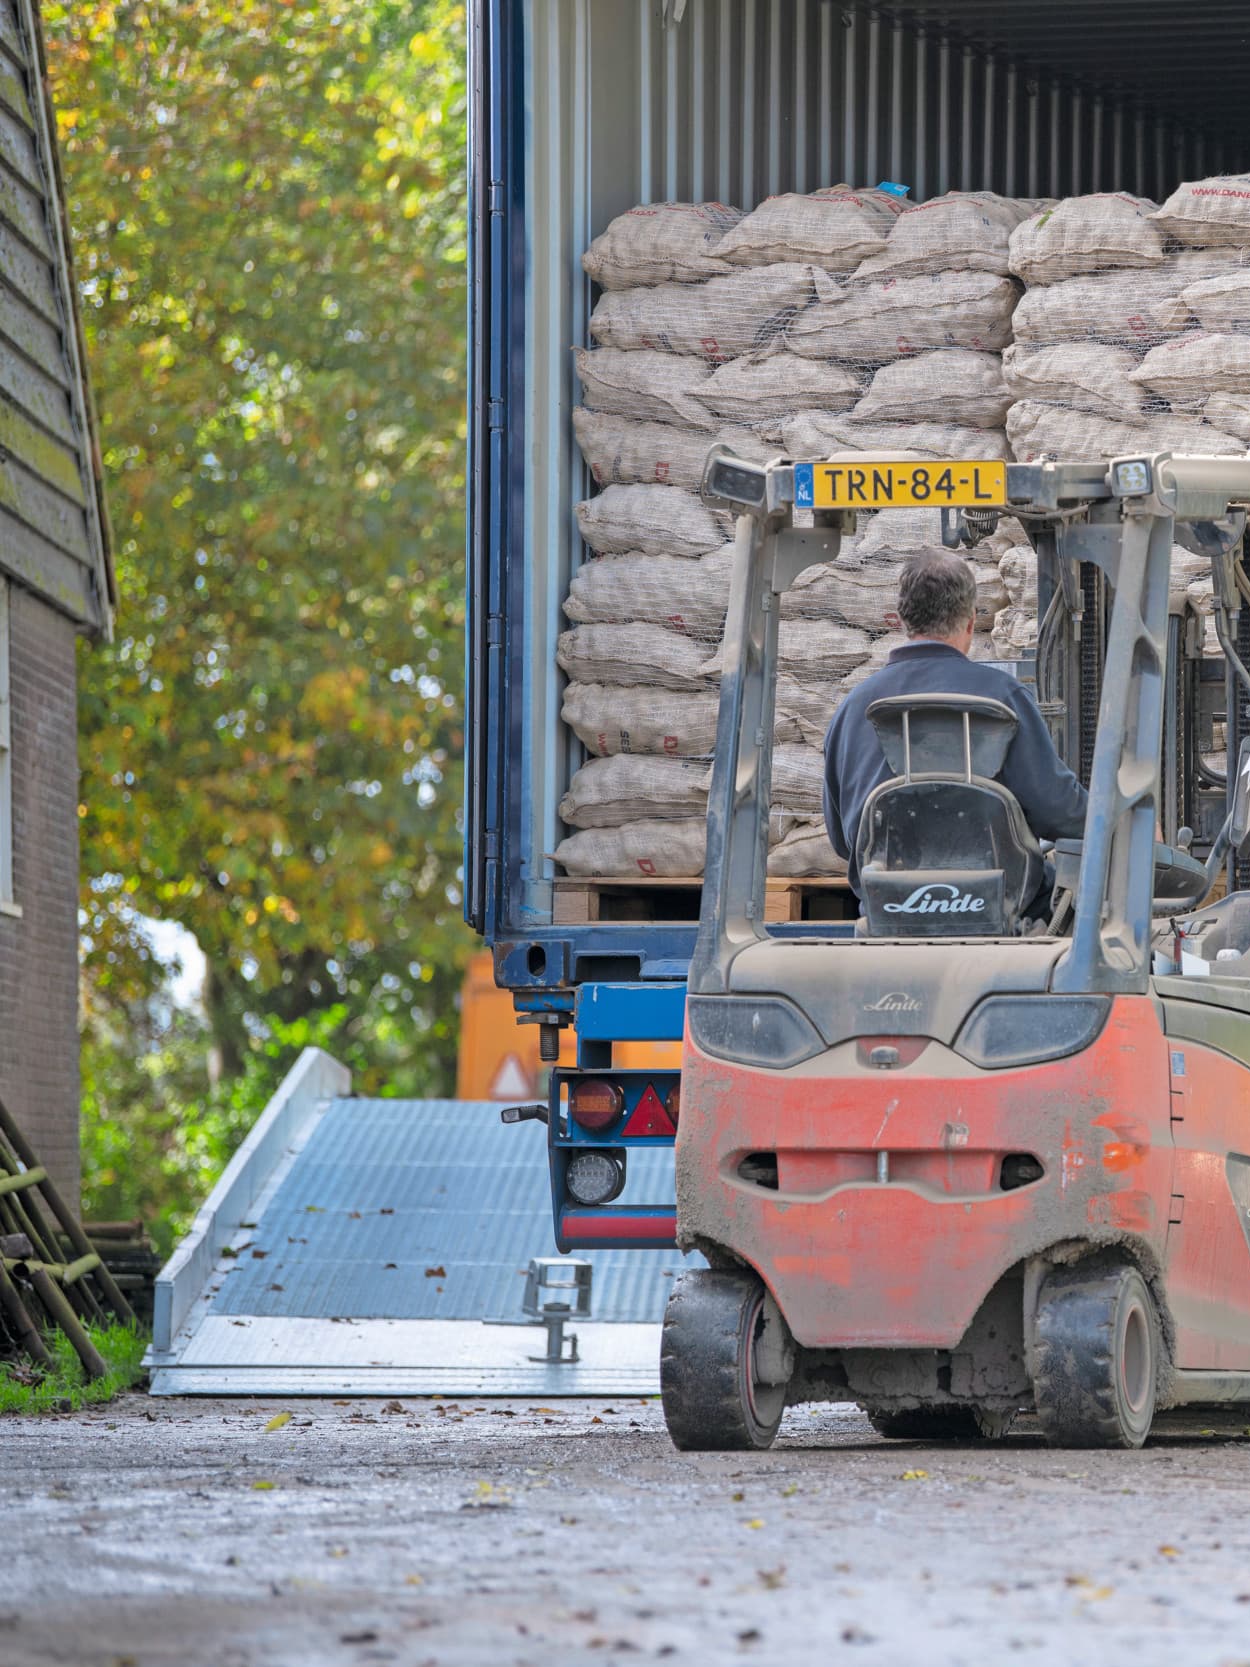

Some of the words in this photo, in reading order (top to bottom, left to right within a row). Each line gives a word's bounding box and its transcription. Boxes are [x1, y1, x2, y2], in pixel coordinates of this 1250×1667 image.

[798, 491, 812, 501] NL
[824, 468, 992, 501] TRN-84-L
[883, 883, 985, 914] Linde
[863, 992, 923, 1011] Linde
